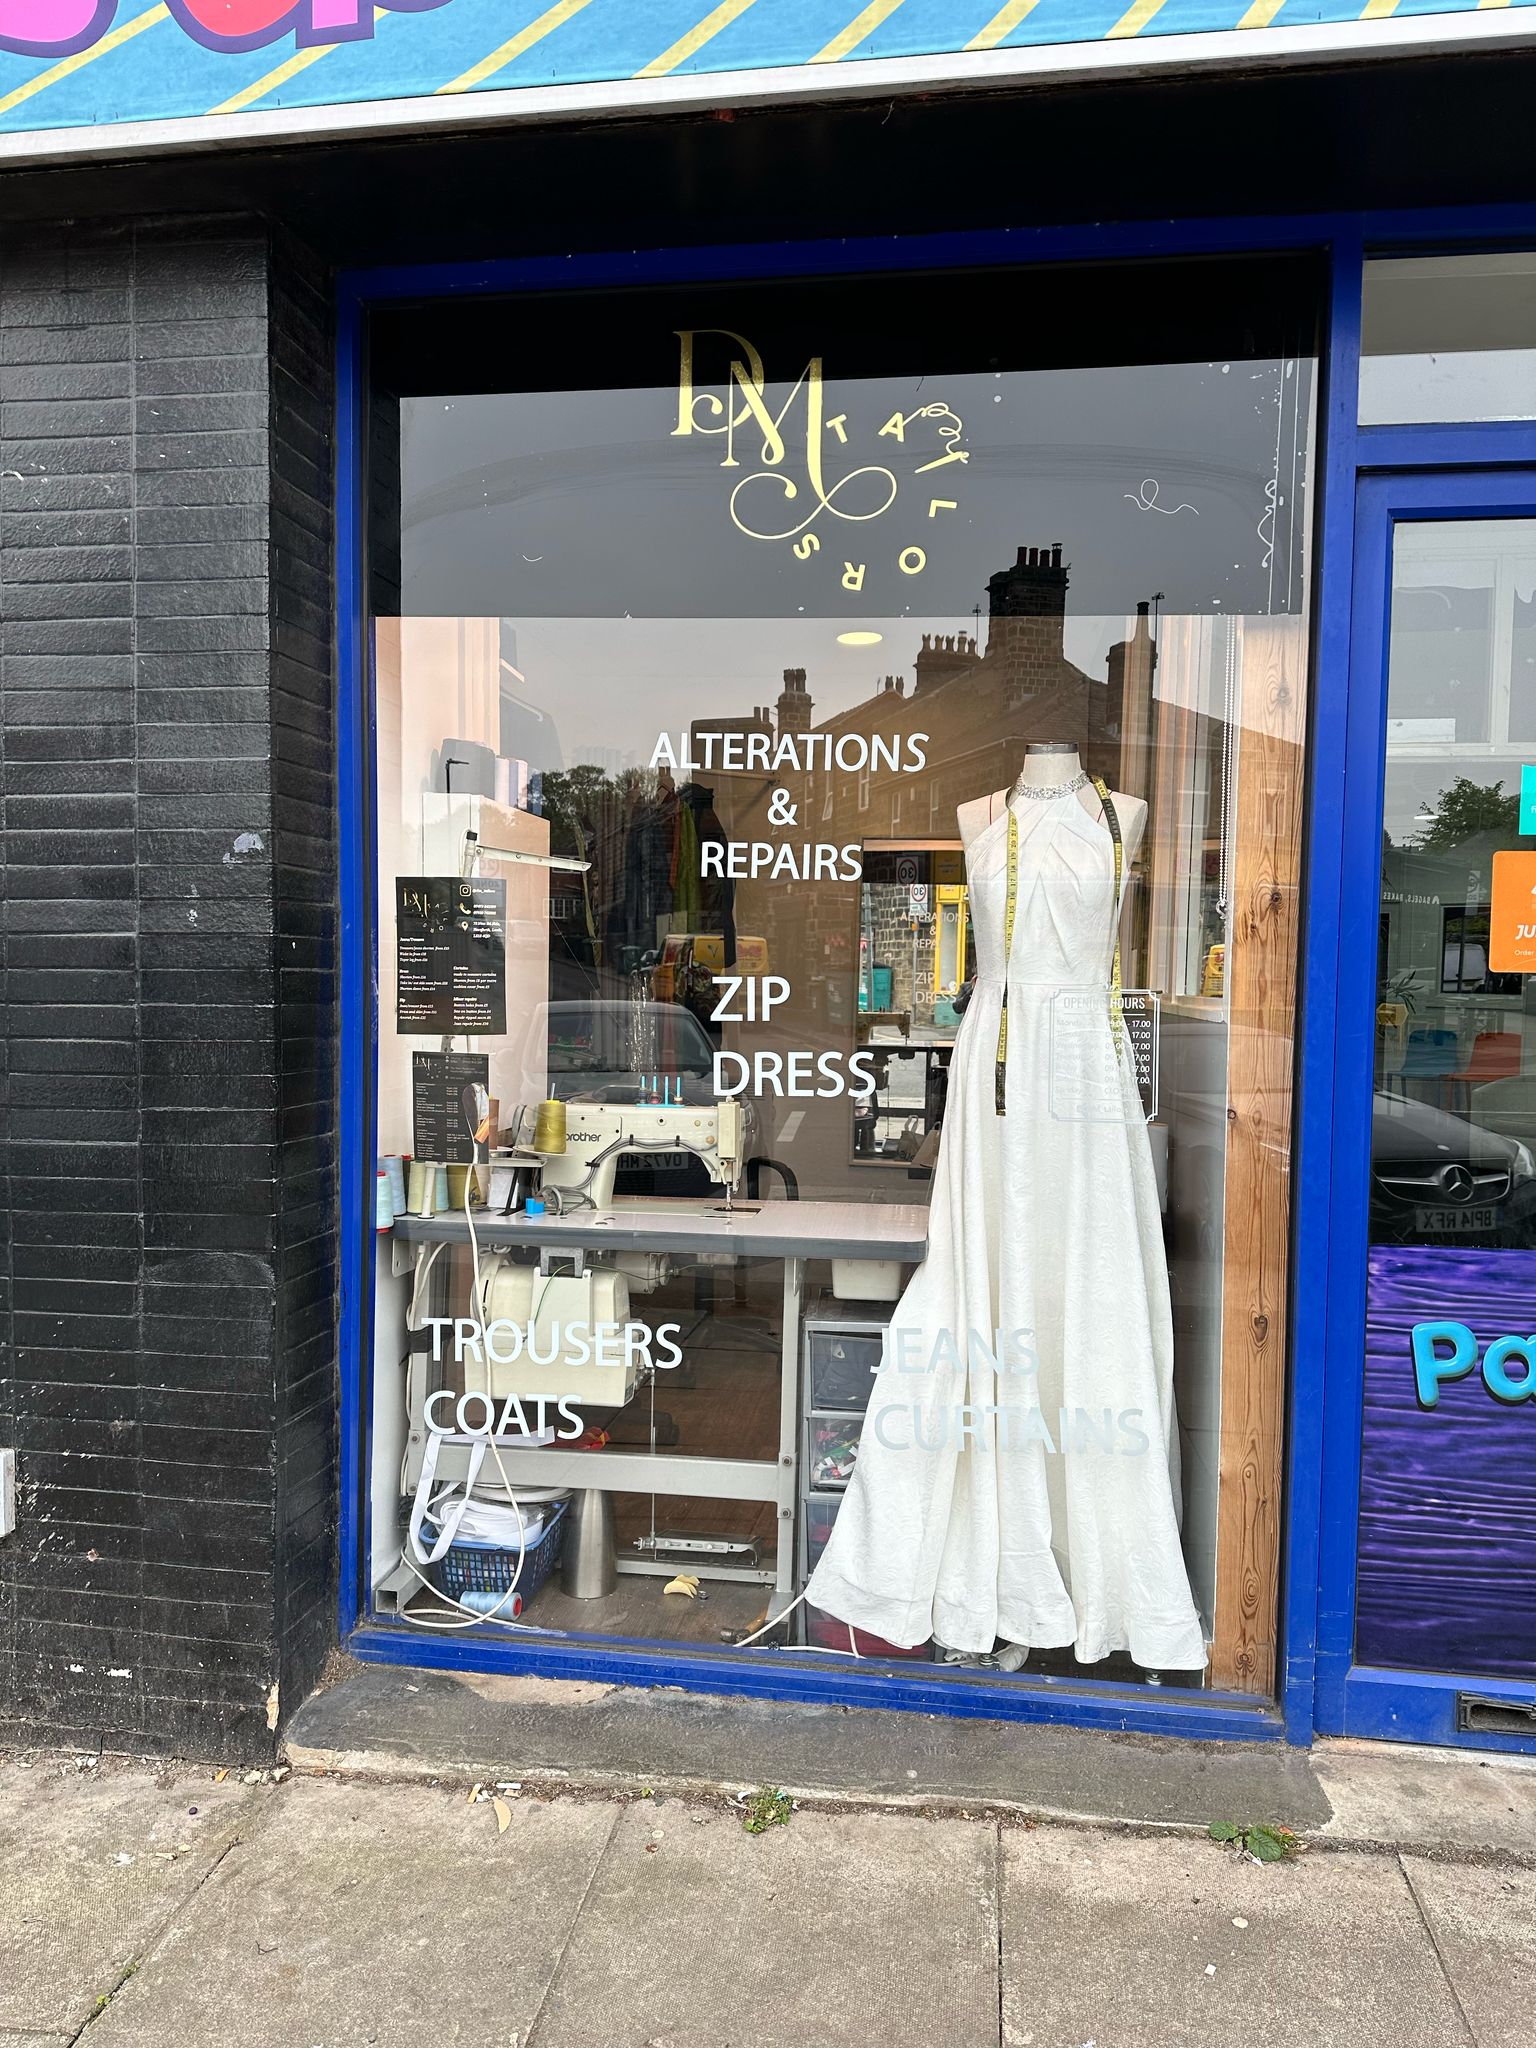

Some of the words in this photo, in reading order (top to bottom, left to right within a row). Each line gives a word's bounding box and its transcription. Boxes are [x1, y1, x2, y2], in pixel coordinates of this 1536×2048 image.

[648, 732, 930, 772] ALTERATIONS
[766, 787, 798, 826] &
[700, 841, 863, 881] REPAIRS
[900, 912, 970, 923] ALTERATIONS
[1515, 924, 1536, 941] JU
[915, 973, 935, 984] ZIP
[915, 992, 957, 1004] DRESS
[710, 975, 791, 1022] ZIP
[1110, 997, 1146, 1009] HOURS
[1132, 1020, 1151, 1028] 17.00
[712, 1051, 878, 1098] DRESS
[1133, 1076, 1150, 1084] 7.00
[421, 1317, 683, 1369] TROUSERS
[870, 1327, 1040, 1376] JEANS
[423, 1390, 584, 1440] COATS
[874, 1403, 1150, 1457] CURTAINS
